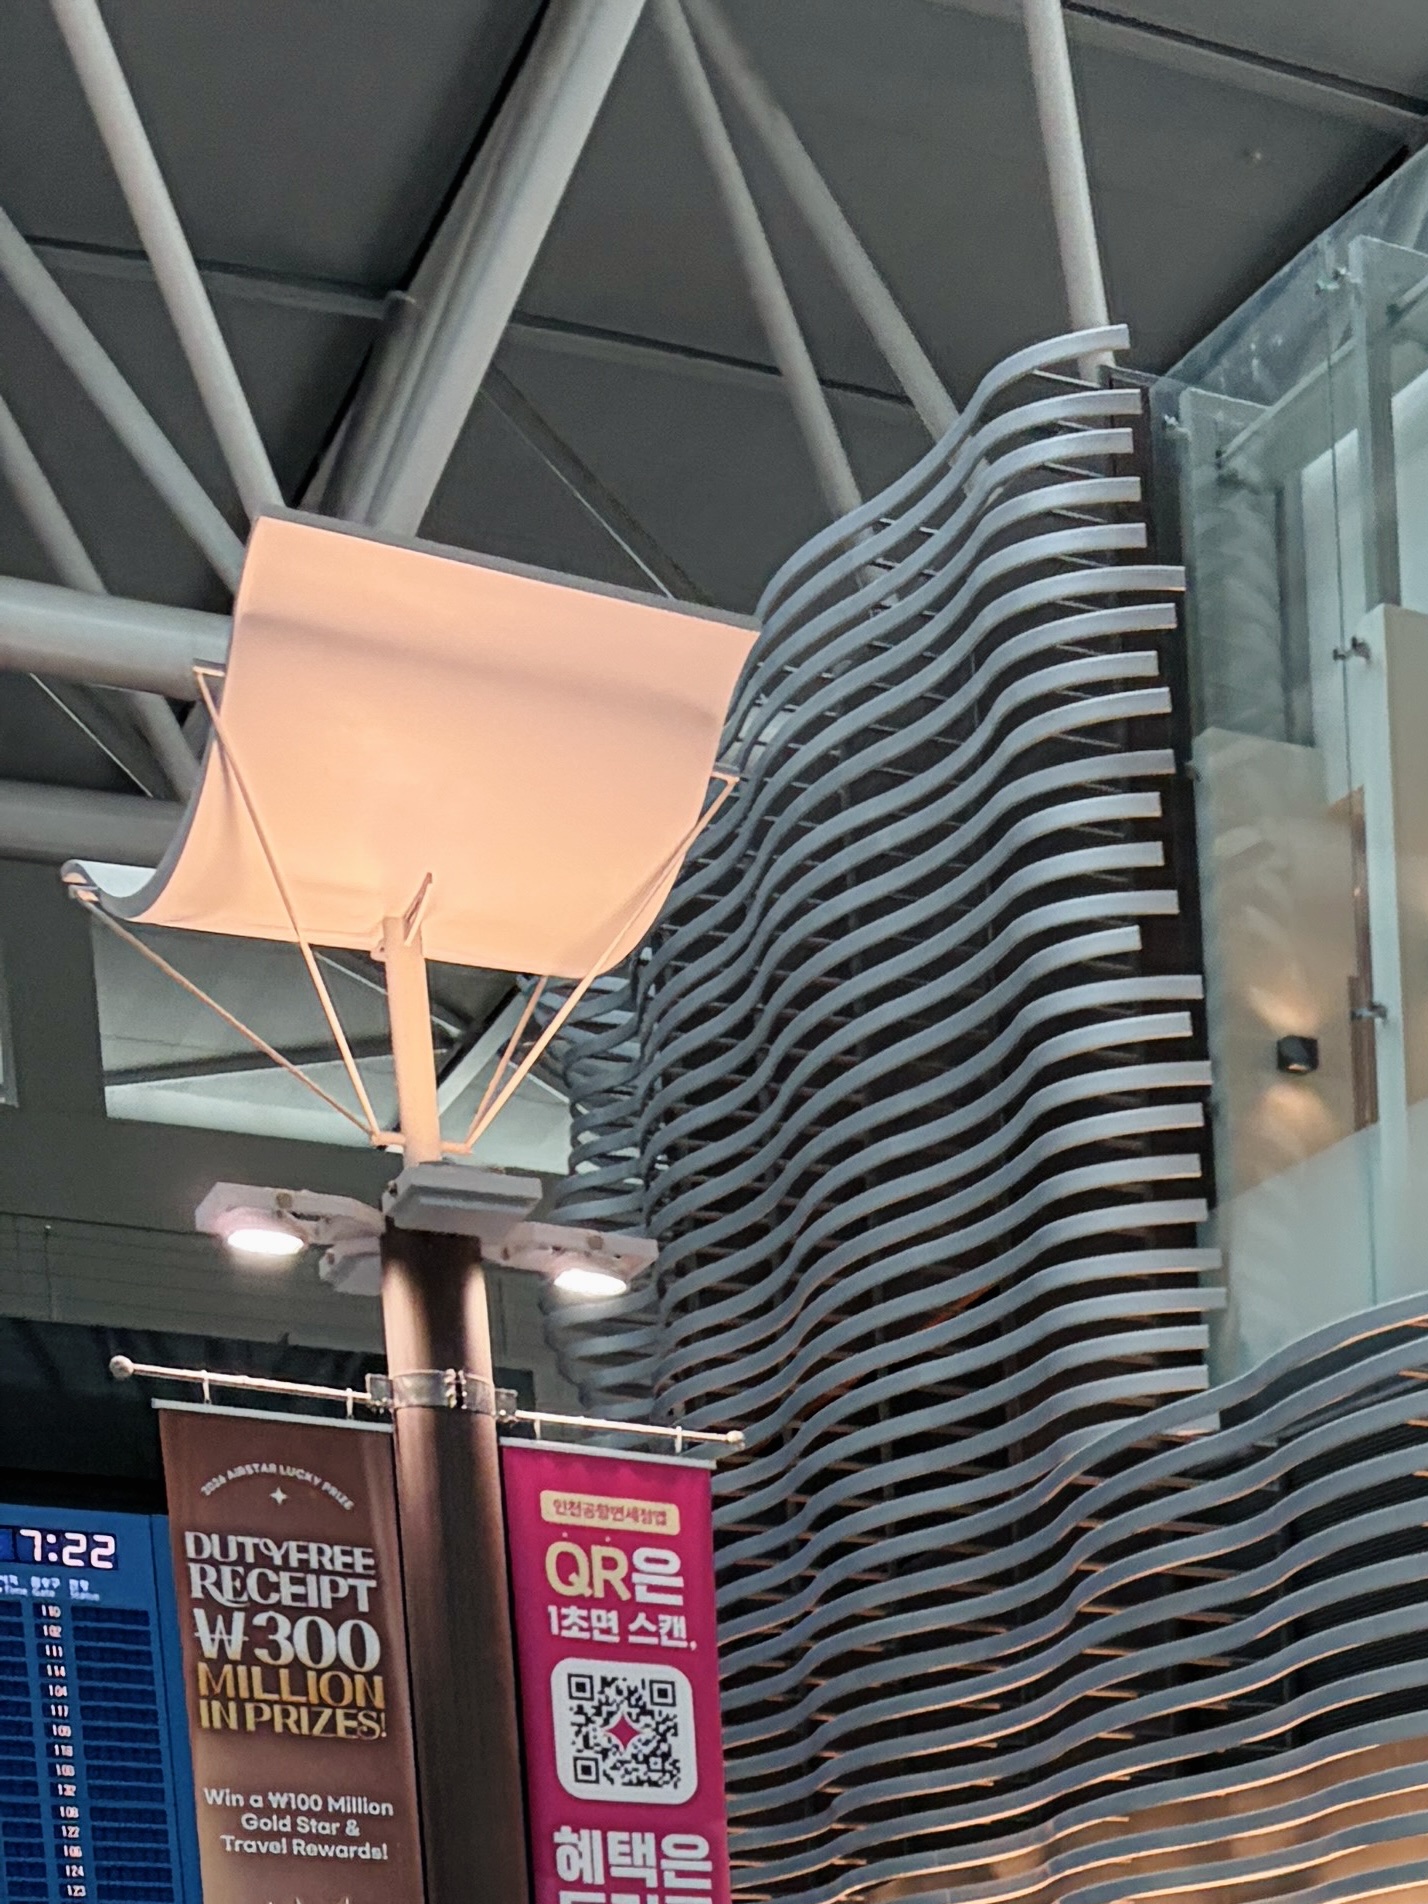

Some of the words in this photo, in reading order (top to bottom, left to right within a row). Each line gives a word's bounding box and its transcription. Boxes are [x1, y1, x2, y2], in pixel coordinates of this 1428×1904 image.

[227, 1462, 277, 1481] AIRSTAR
[279, 1464, 320, 1488] LUCKY
[321, 1482, 354, 1510] PRIZE
[184, 1531, 376, 1575] DUTYFREE
[545, 1540, 684, 1606] QR은
[188, 1562, 377, 1613] RECEIPT
[548, 1605, 620, 1643] 1초면
[628, 1612, 697, 1651] 스캔,
[197, 1661, 386, 1710] MILLION
[200, 1699, 238, 1731] IN
[245, 1702, 388, 1740] PRIZES!
[204, 1787, 244, 1808] Win
[249, 1794, 264, 1808] a
[327, 1795, 395, 1817] Million
[240, 1813, 292, 1832] Gold
[296, 1816, 341, 1835] Star
[345, 1819, 361, 1837] &
[219, 1834, 288, 1855] Travel
[292, 1838, 389, 1860] Rewards!
[553, 1825, 714, 1890] 혜택은
